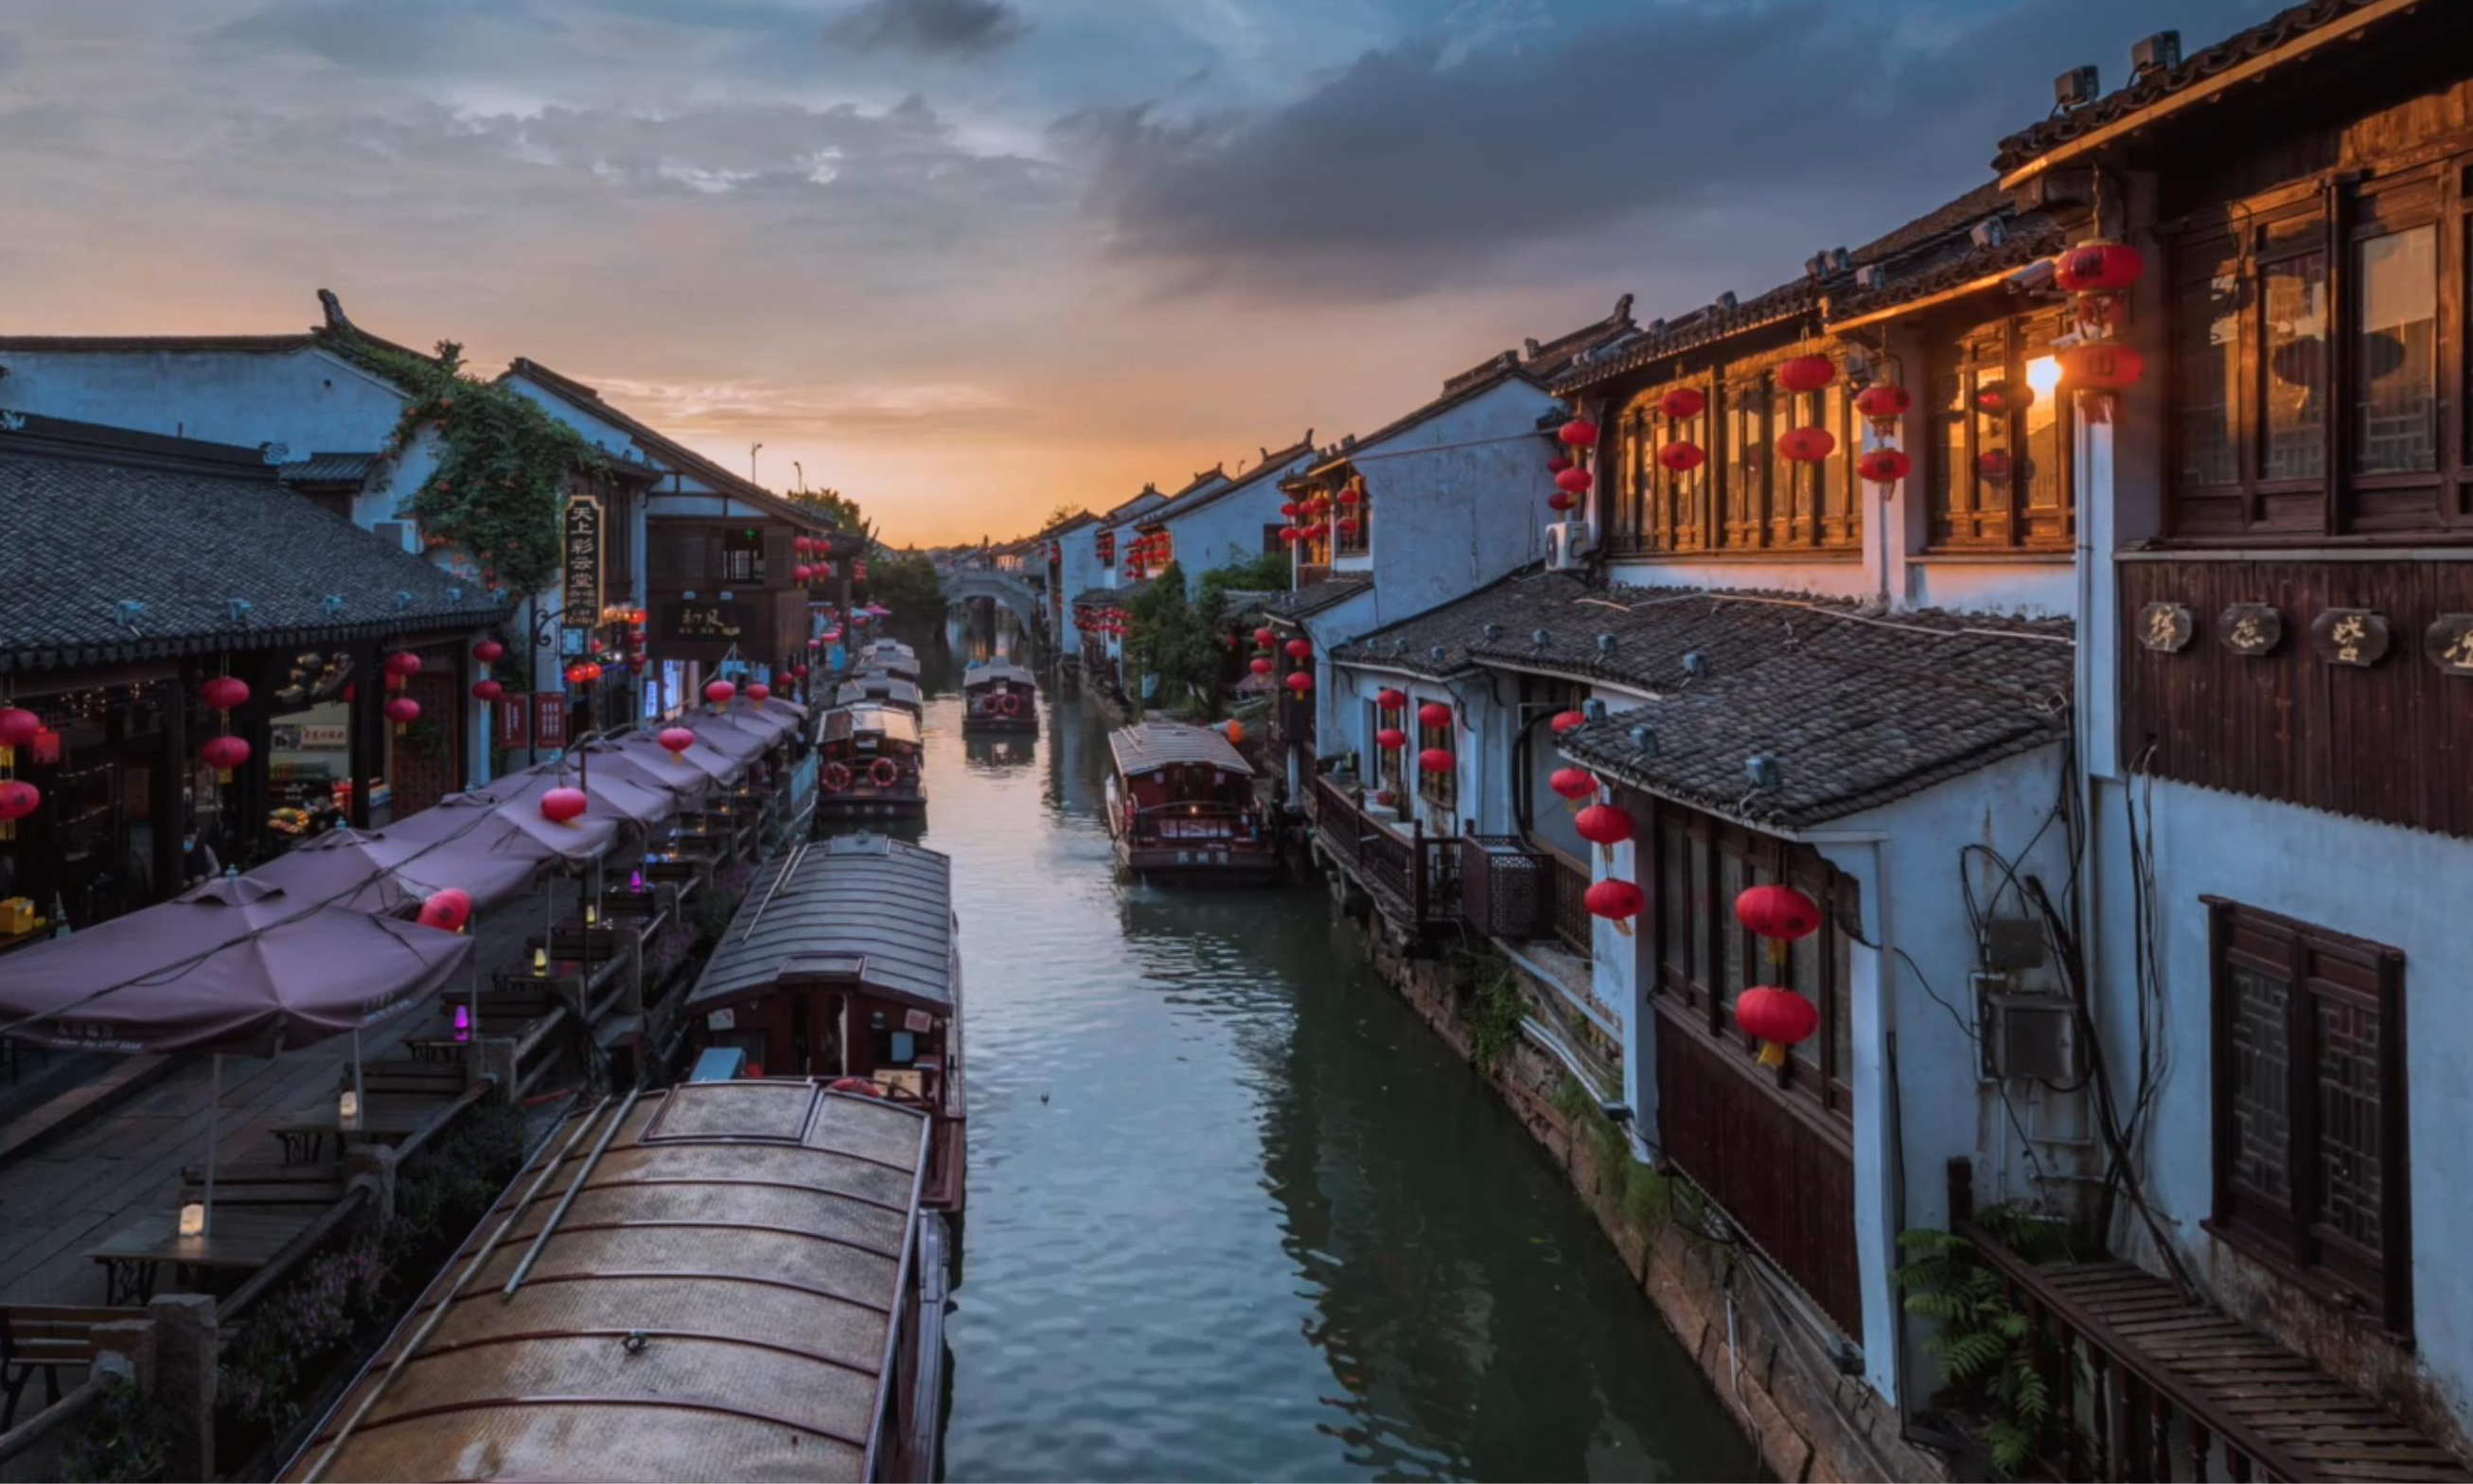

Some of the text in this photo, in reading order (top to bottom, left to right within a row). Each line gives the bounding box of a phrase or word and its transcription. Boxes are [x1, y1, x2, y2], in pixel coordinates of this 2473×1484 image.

[570, 507, 594, 589] 天上彩云堂
